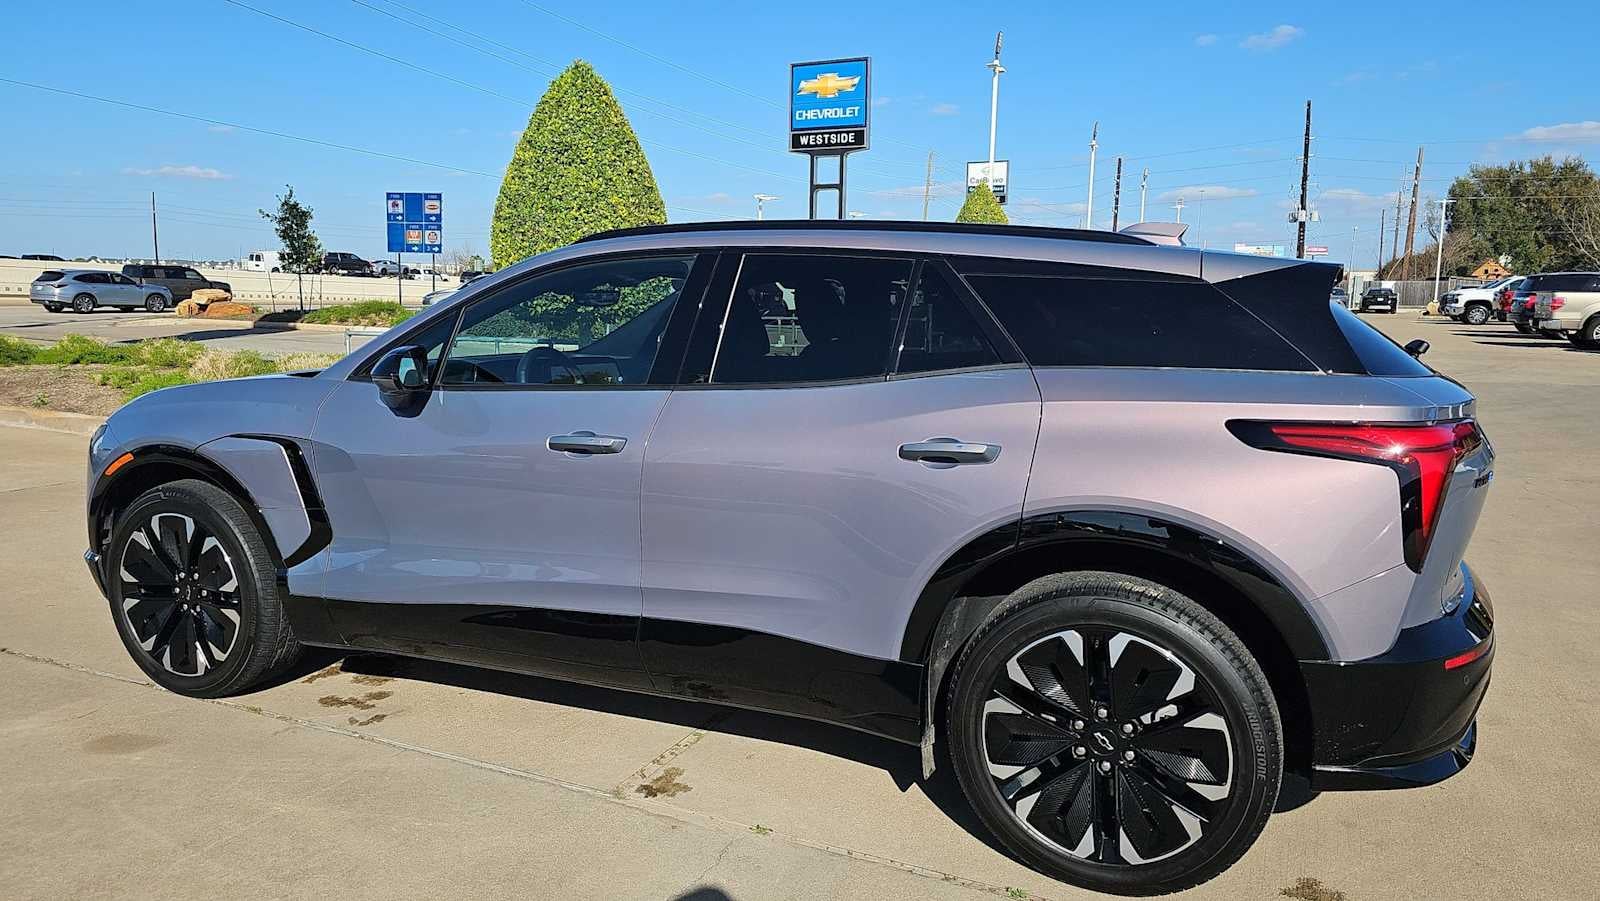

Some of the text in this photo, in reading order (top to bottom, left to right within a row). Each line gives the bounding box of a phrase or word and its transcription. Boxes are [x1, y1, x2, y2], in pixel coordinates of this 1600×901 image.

[795, 106, 860, 121] CHEVROLET
[799, 133, 855, 145] WESTSIDE
[969, 176, 1004, 184] CarBvo
